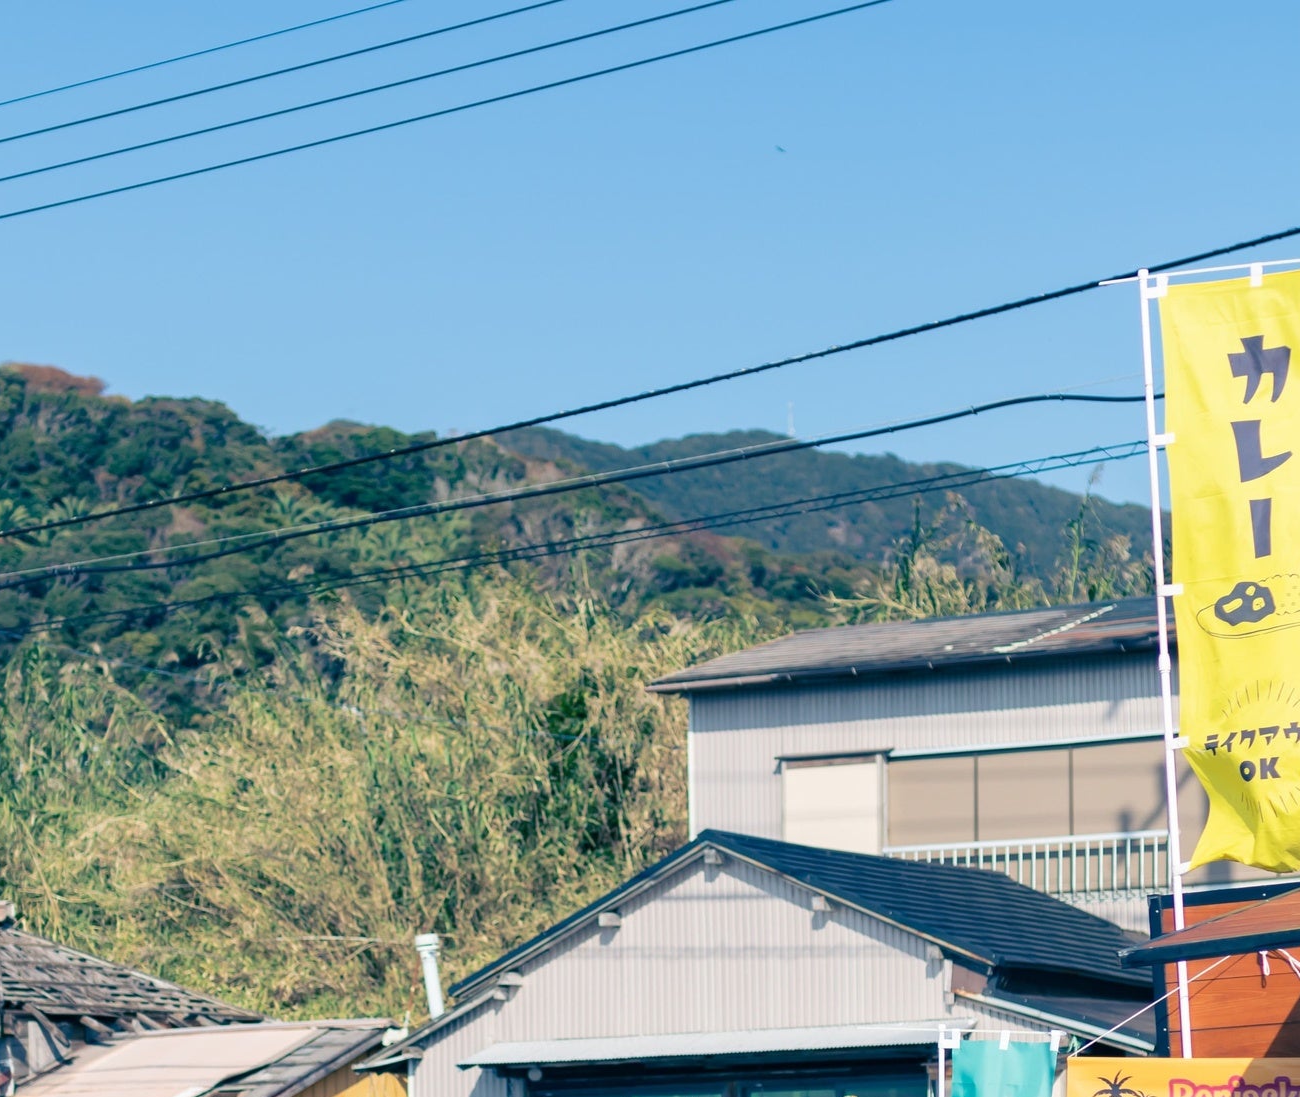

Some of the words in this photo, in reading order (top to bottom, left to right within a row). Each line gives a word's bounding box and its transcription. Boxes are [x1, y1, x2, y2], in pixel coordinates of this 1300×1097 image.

[1226, 335, 1293, 558] カレー
[1239, 756, 1281, 782] OK
